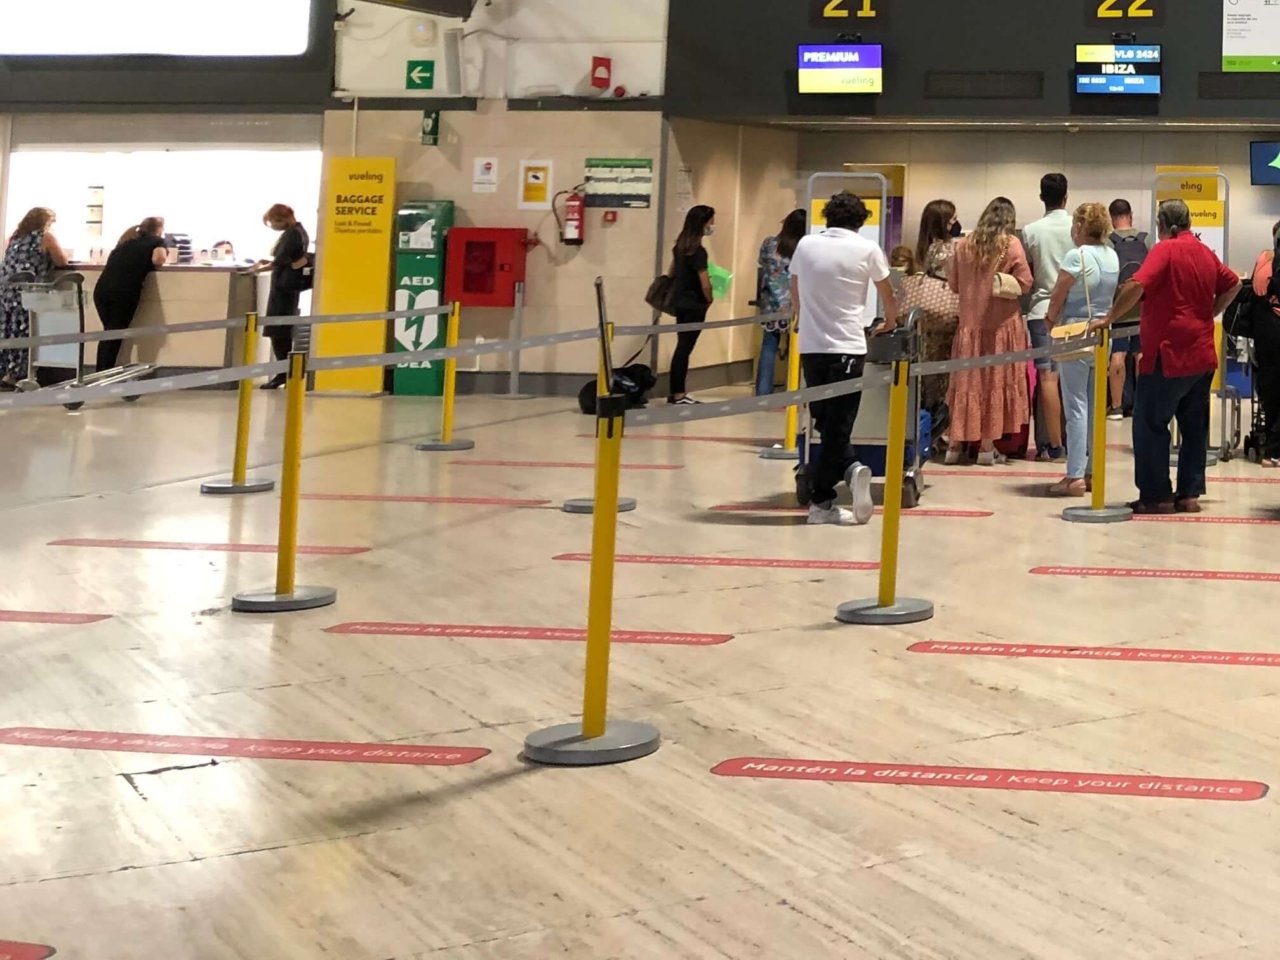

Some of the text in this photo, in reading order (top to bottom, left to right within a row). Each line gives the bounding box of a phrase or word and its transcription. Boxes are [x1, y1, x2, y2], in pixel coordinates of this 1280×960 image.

[803, 52, 860, 63] PREMIUM
[1101, 64, 1136, 75] IBIZA
[349, 171, 384, 184] vueling
[1181, 181, 1203, 192] eling
[336, 194, 384, 205] BAGGAGE
[335, 206, 377, 216] SERVICE
[1190, 210, 1217, 219] vueling
[400, 276, 435, 285] AED
[930, 643, 1005, 652] Mantén
[1033, 647, 1122, 657] distancia
[1138, 651, 1185, 659] Keep
[302, 747, 358, 755] your
[362, 749, 463, 760] distance
[742, 762, 838, 774] Mantén
[844, 768, 868, 776] la
[873, 769, 989, 782] distancia
[1007, 775, 1069, 786] Keep
[1073, 780, 1131, 788] your
[1138, 781, 1244, 794] distance
